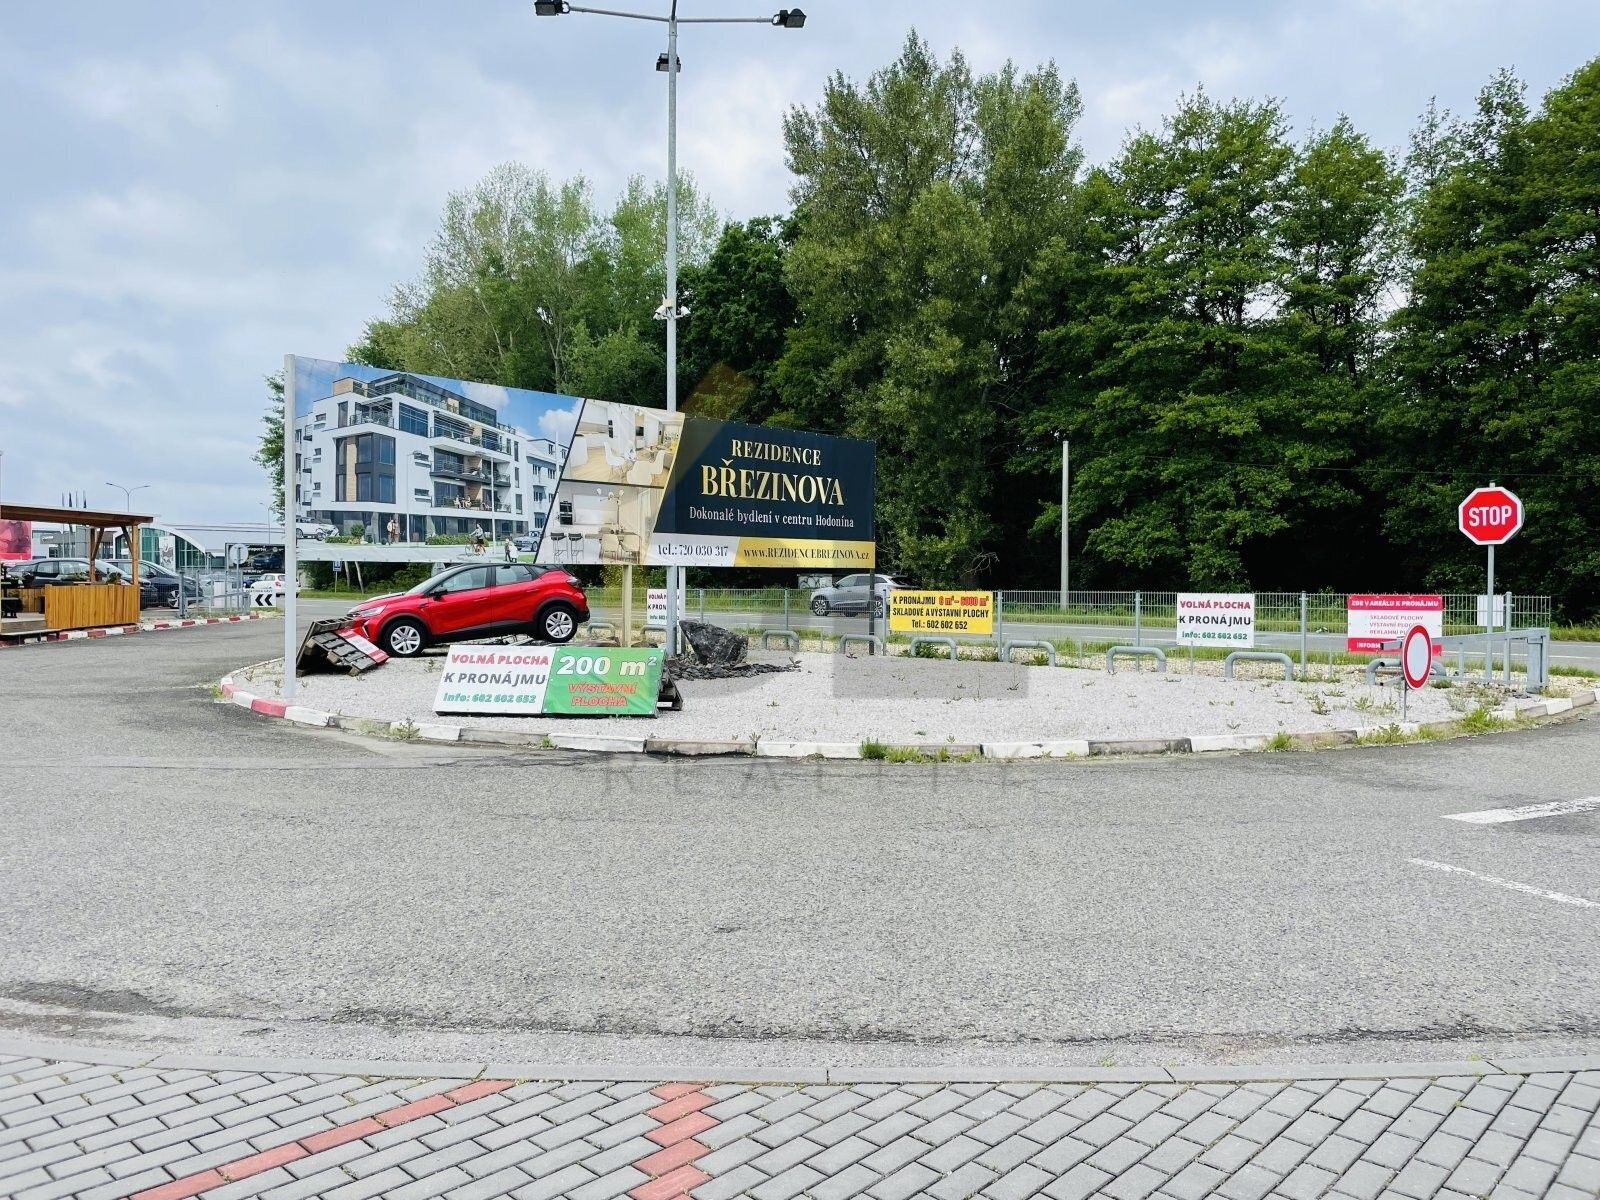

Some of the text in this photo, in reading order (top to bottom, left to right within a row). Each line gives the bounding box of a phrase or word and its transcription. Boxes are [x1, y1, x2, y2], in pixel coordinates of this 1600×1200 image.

[731, 439, 821, 466] REZIDENCE
[701, 458, 845, 506] BŘEZINOVA
[689, 506, 855, 528] Dokonalé bydlení v centru Hodonína
[1468, 504, 1512, 527] STOP
[679, 543, 693, 556] 720
[695, 544, 713, 557] 030
[714, 545, 729, 557] 317
[743, 547, 870, 560] www.REZIDENCEBREZINOVA.cz
[893, 596, 898, 604] K
[899, 595, 936, 605] PRONÁJMU
[1180, 600, 1251, 609] VOLNÁ PLOCHA
[892, 607, 924, 617] SKLADOVÉ
[963, 609, 989, 618] PLOCHY
[912, 619, 968, 630] Tel.: 602 602 652
[1179, 614, 1251, 627] K PRONÁJMU
[1201, 631, 1216, 639] 602
[1232, 632, 1248, 640] 652
[451, 653, 549, 666] VOLNÁ PLOCHA
[557, 655, 658, 676] 200 m²
[443, 670, 547, 687] K PRONÁJMU
[472, 693, 493, 703] 602
[494, 694, 515, 703] 602
[515, 694, 537, 704] 652
